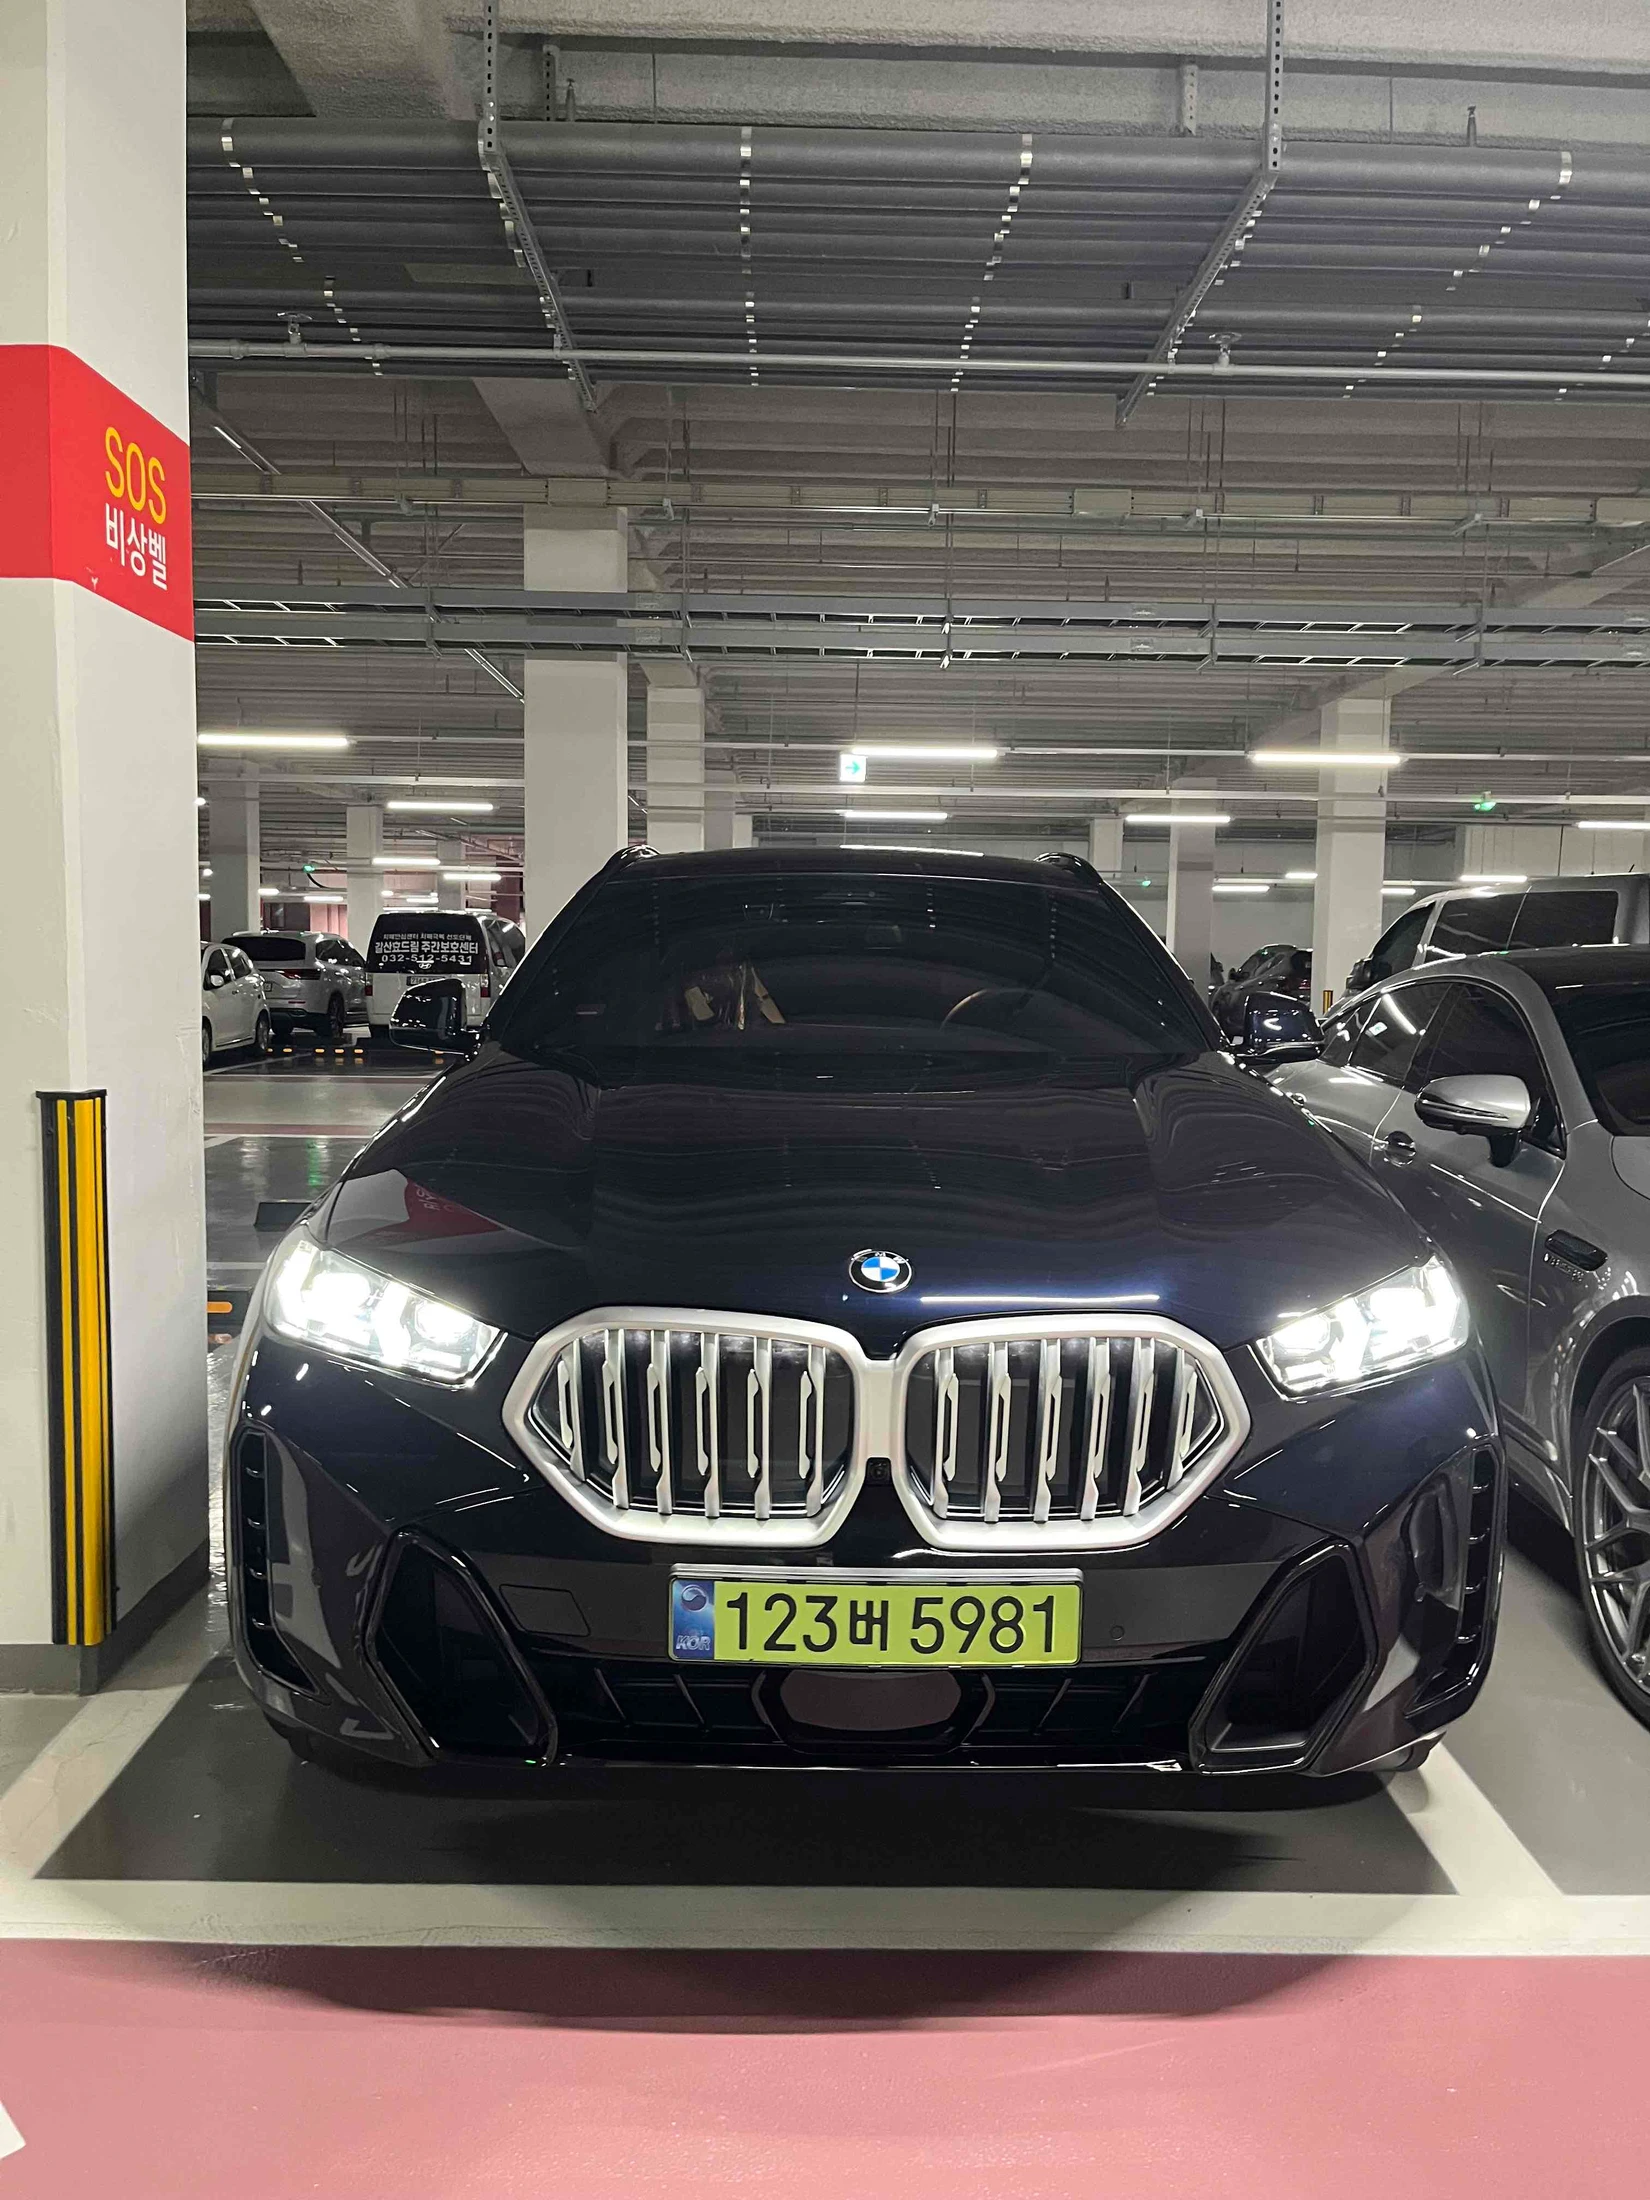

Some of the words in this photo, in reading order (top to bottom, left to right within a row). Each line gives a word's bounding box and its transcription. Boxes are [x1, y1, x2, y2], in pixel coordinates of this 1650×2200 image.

[105, 427, 166, 524] SOS
[105, 502, 168, 591] 비상벨
[375, 941, 419, 954] 갈산효드림
[421, 941, 478, 955] 주간보호센터
[381, 953, 472, 963] 032-512-5431
[675, 1634, 711, 1652] KOR
[726, 1591, 889, 1653] 123버
[909, 1594, 1055, 1655] 5981
